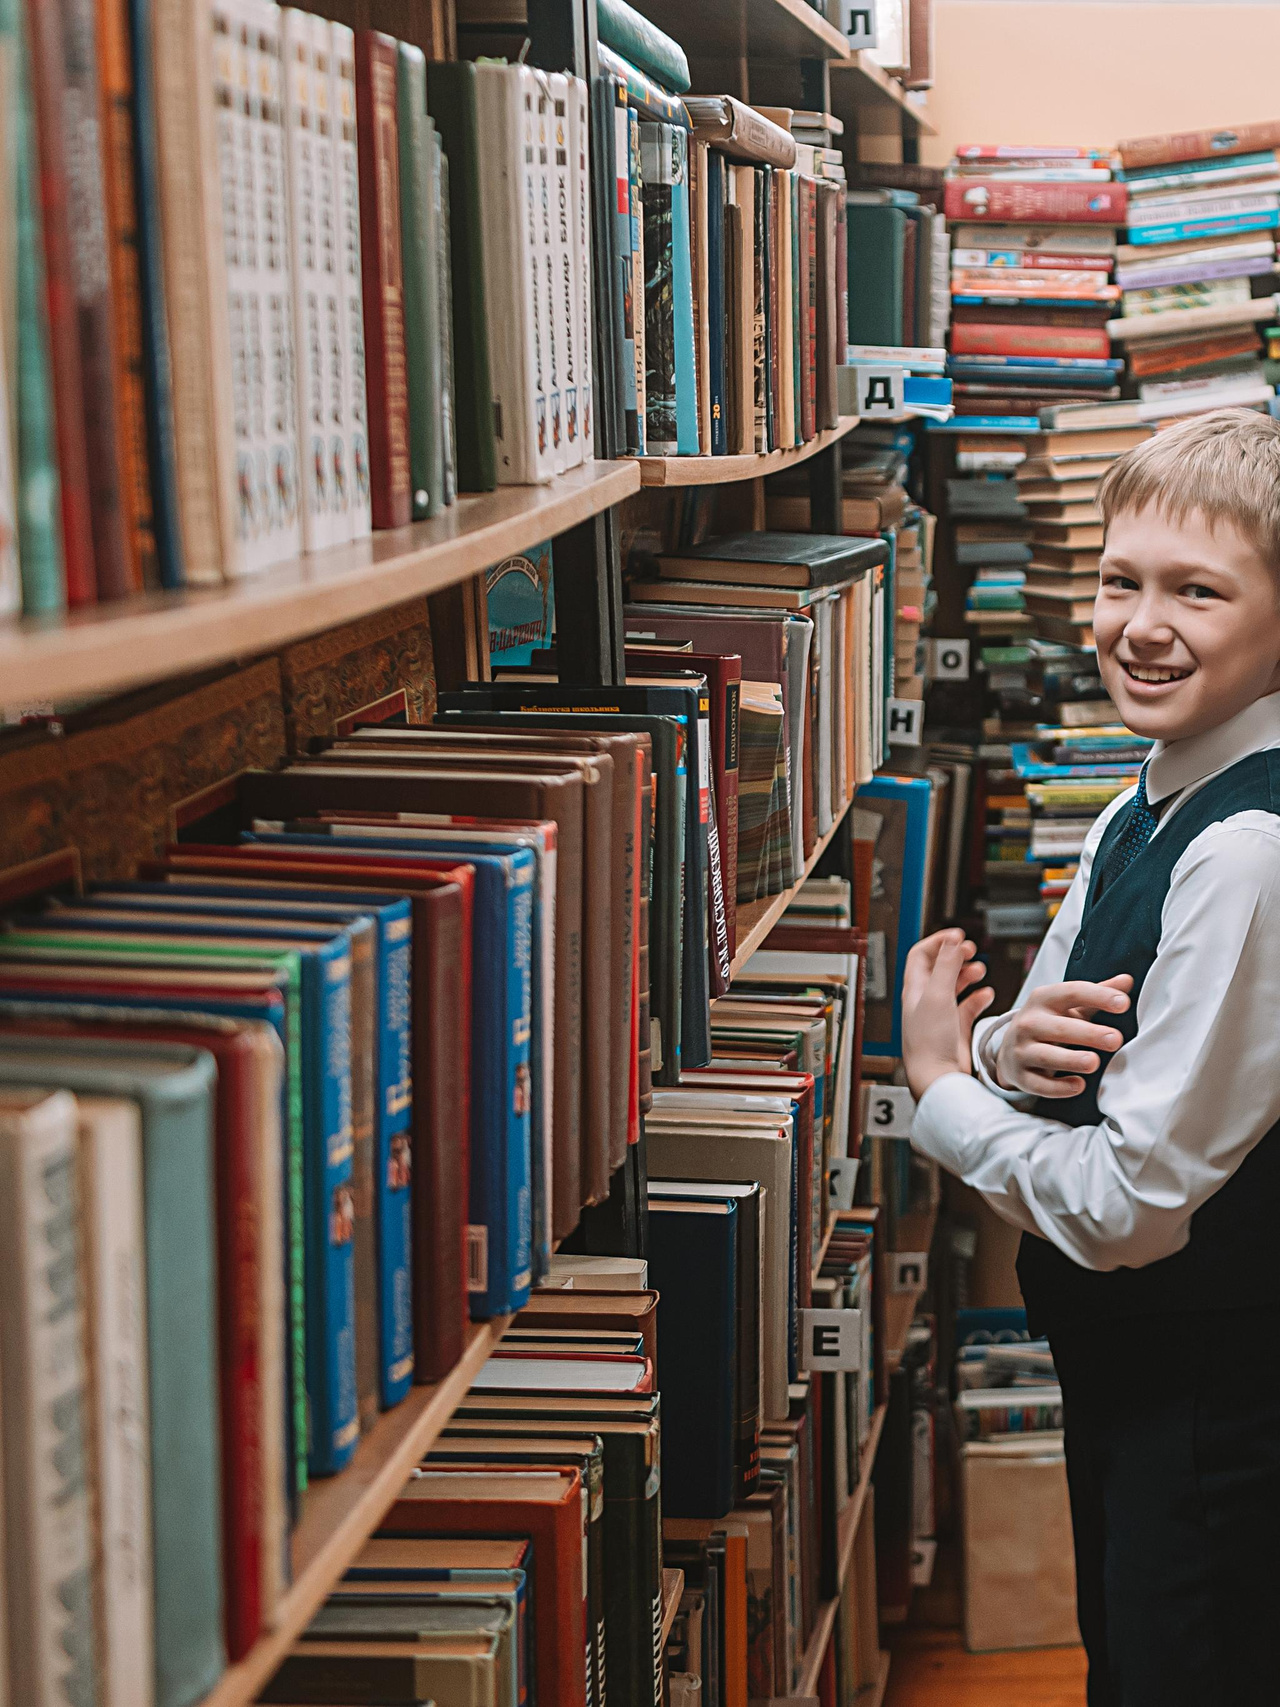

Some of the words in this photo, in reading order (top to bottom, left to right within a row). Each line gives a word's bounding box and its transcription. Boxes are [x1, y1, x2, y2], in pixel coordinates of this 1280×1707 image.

[847, 8, 871, 36] Л
[557, 176, 568, 243] БЛОК
[562, 253, 575, 383] Александр
[865, 376, 895, 410] Д
[712, 403, 720, 419] 20
[520, 705, 571, 713] Библиотека
[889, 708, 914, 733] Н
[813, 1326, 841, 1357] Е
